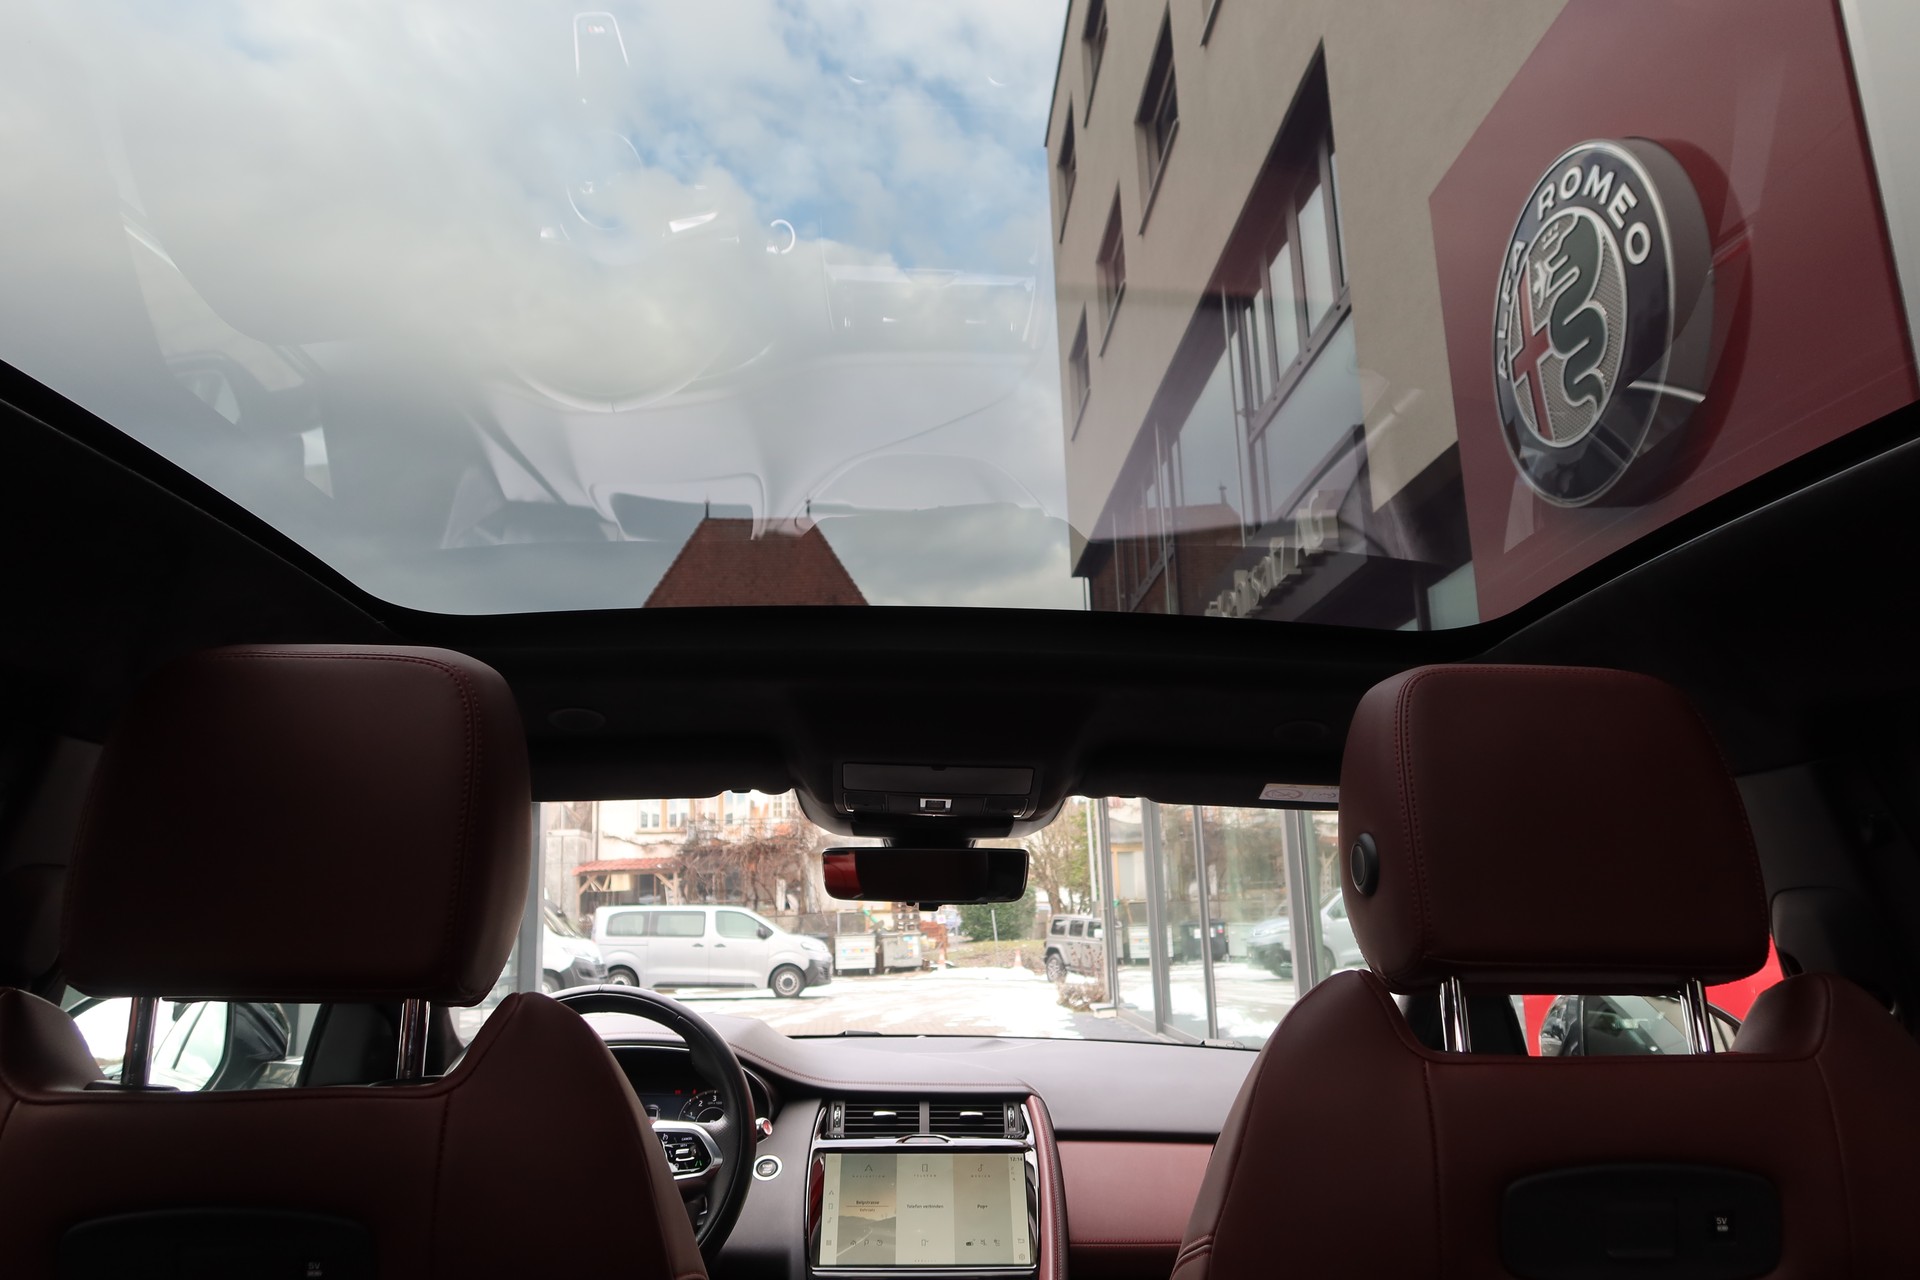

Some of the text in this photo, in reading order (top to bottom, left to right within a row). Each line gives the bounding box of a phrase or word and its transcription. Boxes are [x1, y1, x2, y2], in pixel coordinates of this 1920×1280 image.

[1497, 164, 1651, 381] ALFA ROMEO
[1716, 1217, 1728, 1225] 5V
